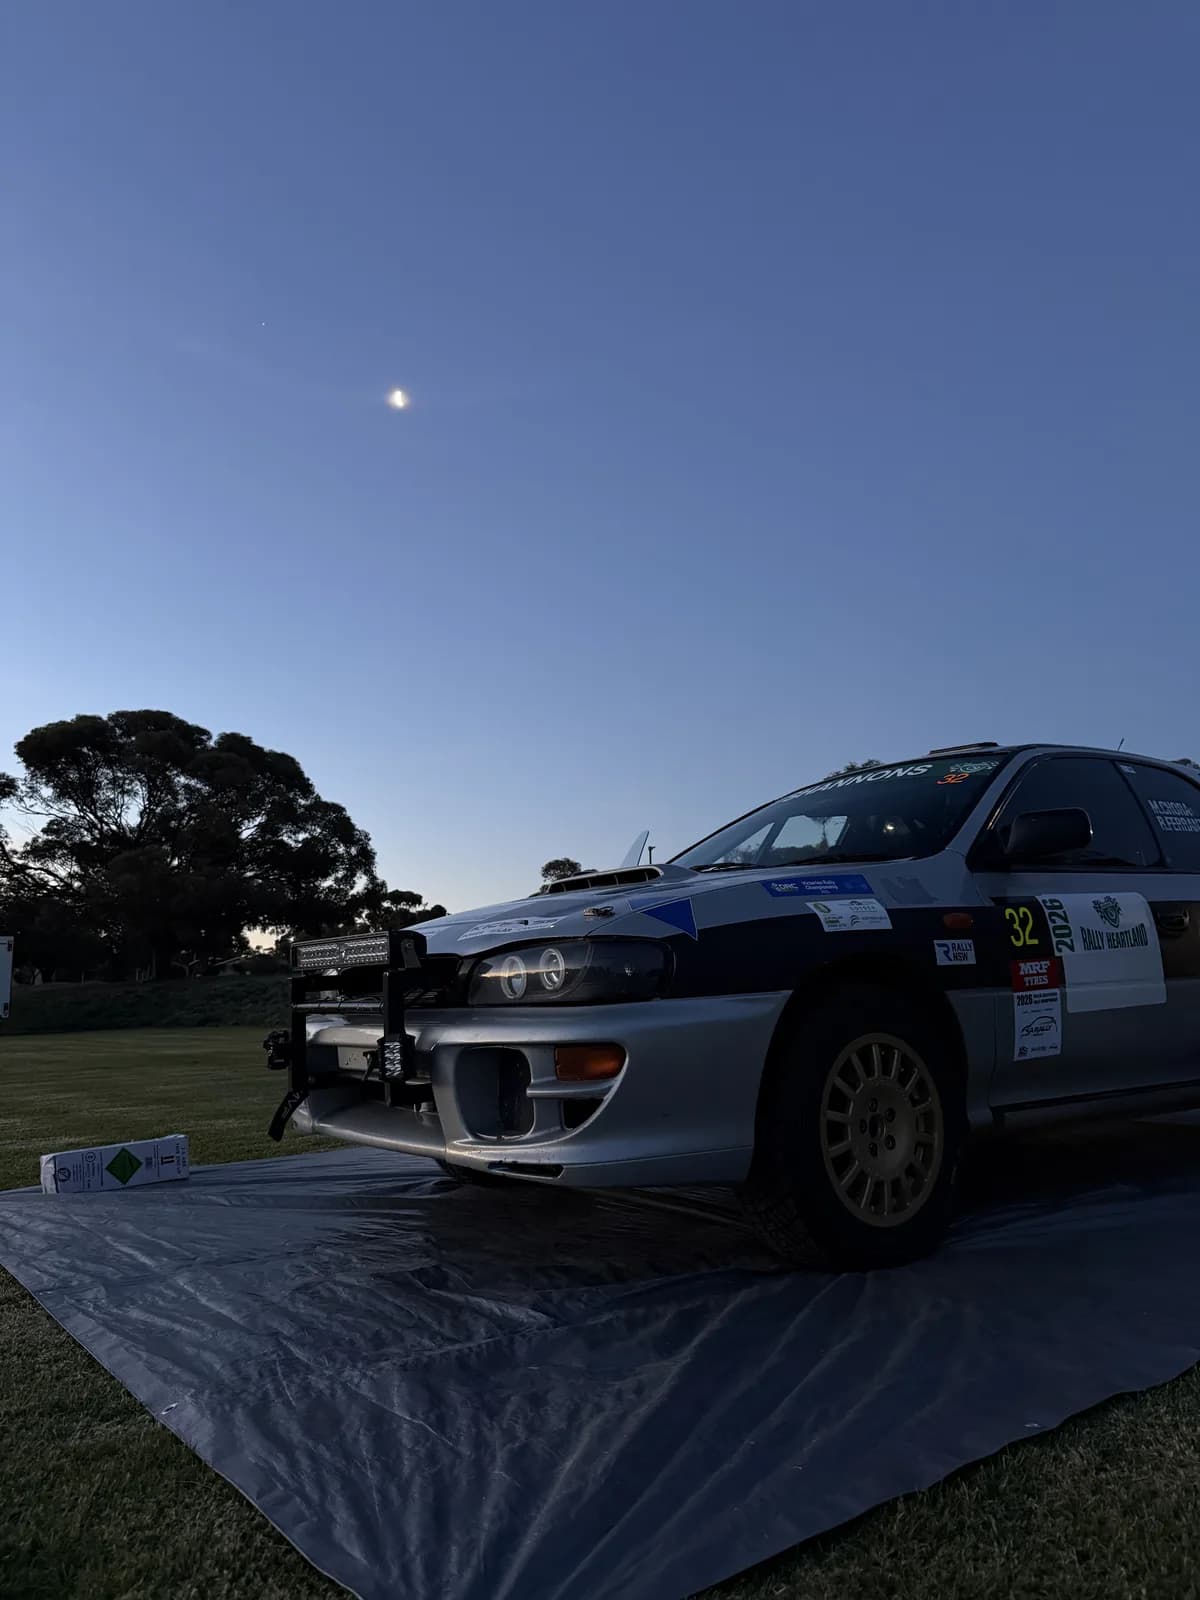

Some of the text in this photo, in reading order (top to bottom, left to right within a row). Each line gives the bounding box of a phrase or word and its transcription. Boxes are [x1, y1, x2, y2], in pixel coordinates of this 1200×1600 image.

[782, 764, 933, 802] SHANNONS
[936, 773, 969, 784] 32
[1005, 906, 1039, 947] 32
[1042, 898, 1075, 952] 2026
[1080, 923, 1148, 951] RALLY HEARTLAND
[951, 942, 973, 951] RALLY
[952, 952, 968, 961] NSW
[1018, 960, 1051, 975] MRF
[1024, 975, 1049, 986] TYRES
[1017, 993, 1033, 1006] 2026
